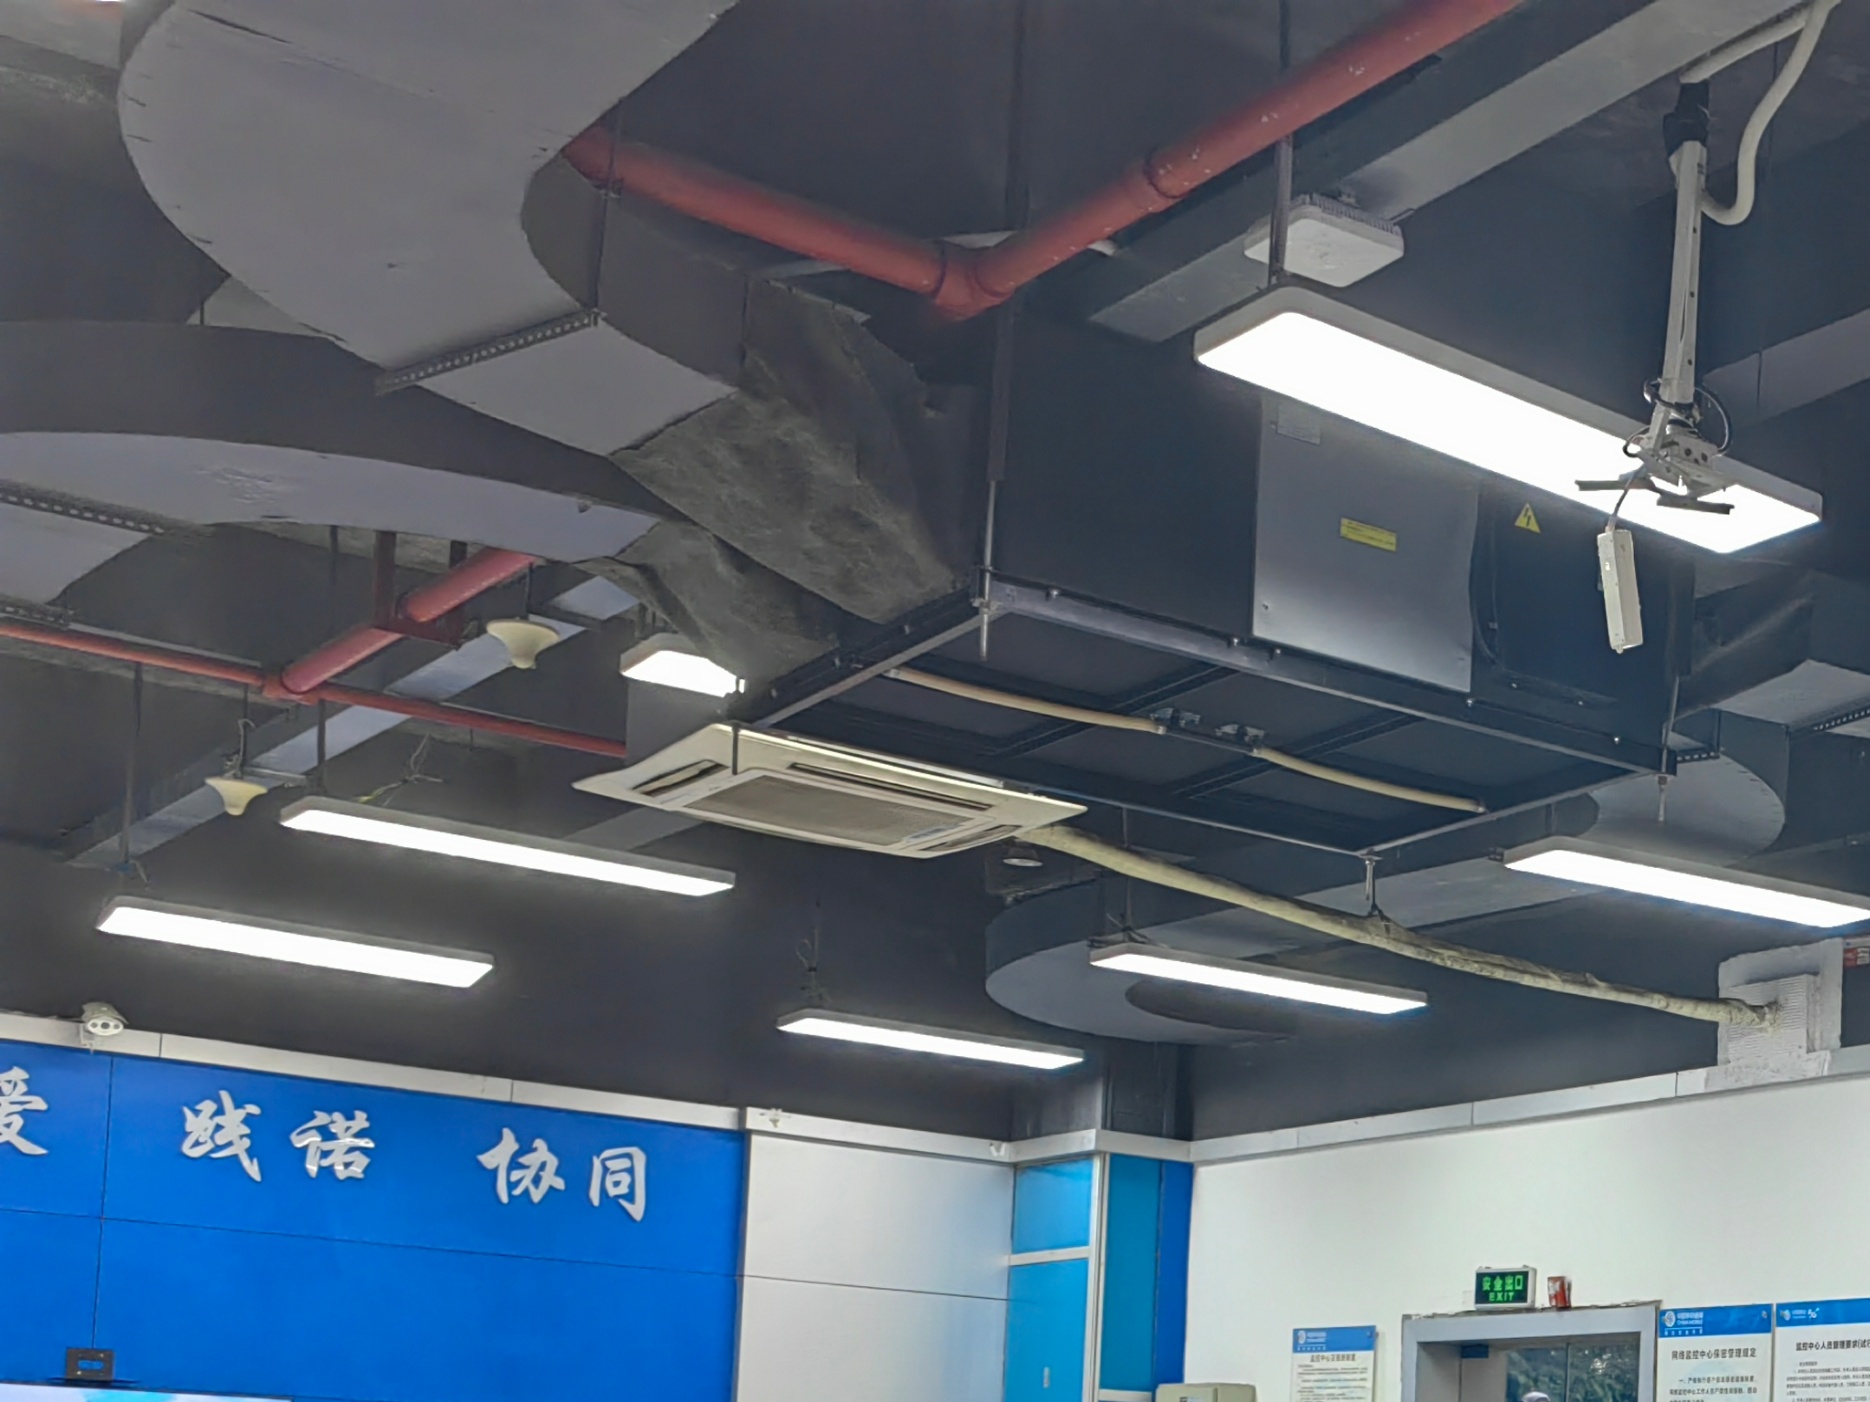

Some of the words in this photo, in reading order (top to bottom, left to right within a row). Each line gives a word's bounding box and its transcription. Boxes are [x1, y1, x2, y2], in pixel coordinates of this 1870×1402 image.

[181, 1089, 375, 1182] 践诺
[477, 1128, 647, 1222] 协同
[1482, 1274, 1524, 1291] 安全出口
[1488, 1291, 1515, 1302] EXIT
